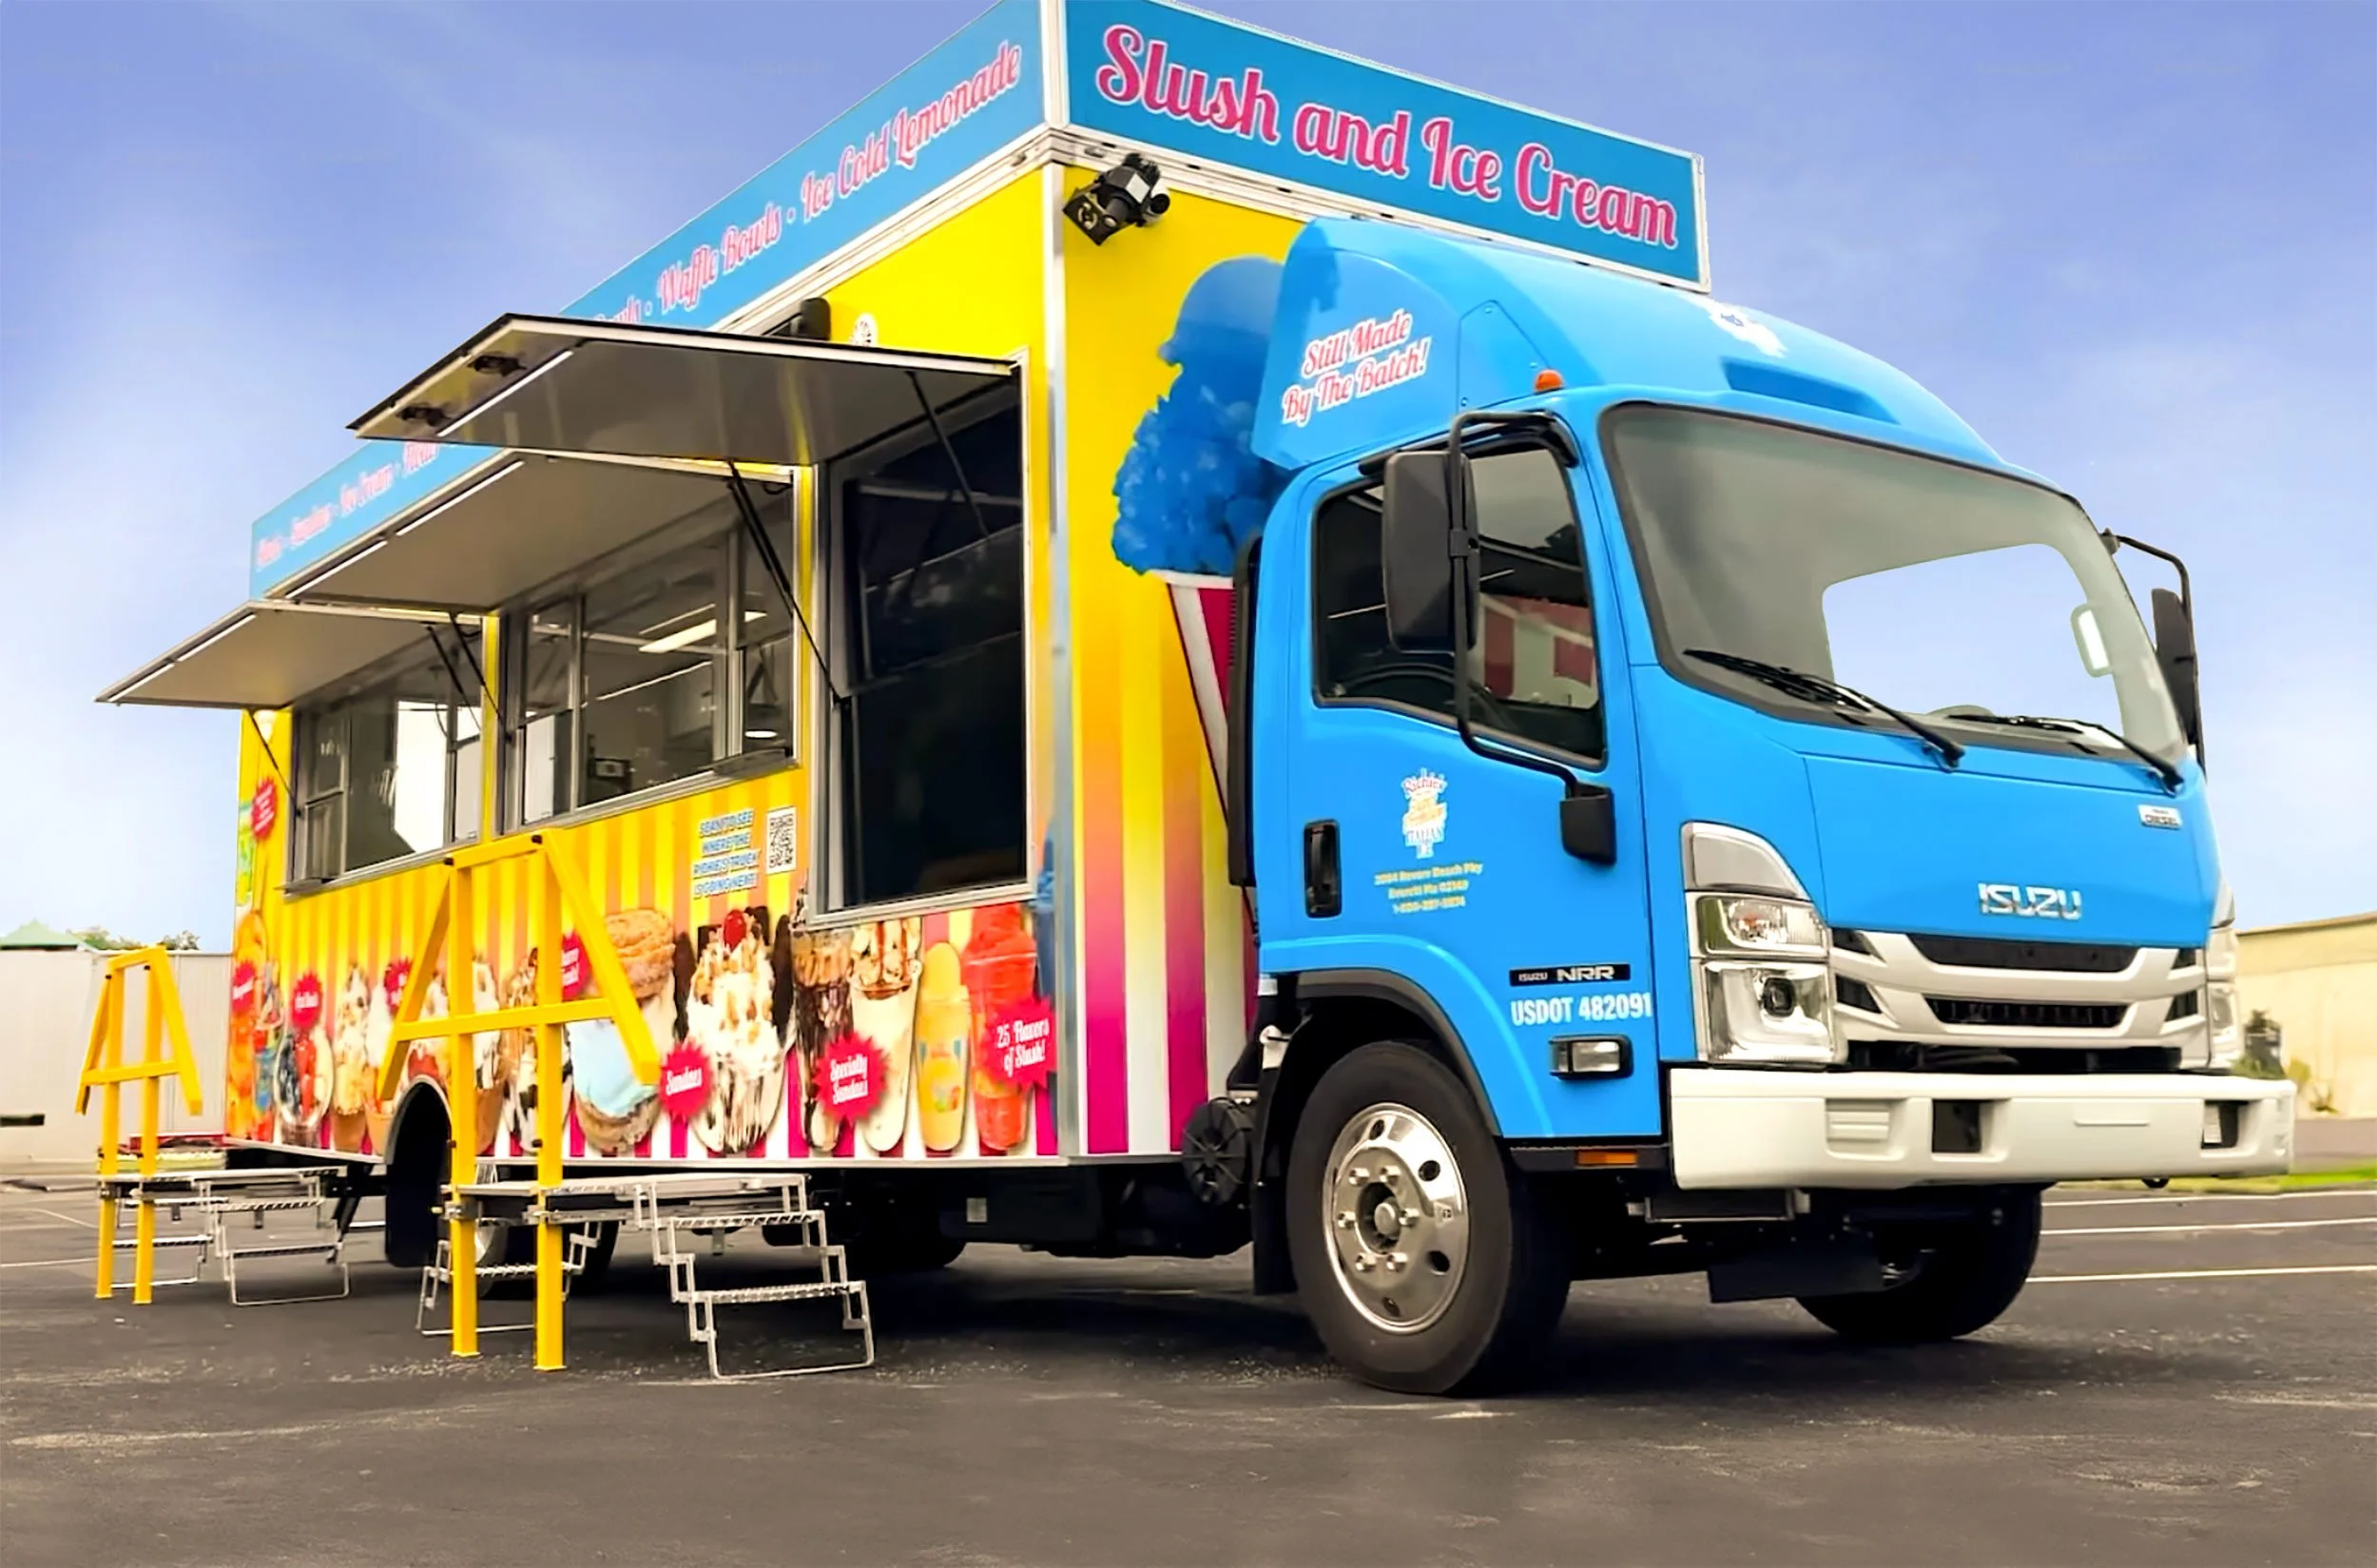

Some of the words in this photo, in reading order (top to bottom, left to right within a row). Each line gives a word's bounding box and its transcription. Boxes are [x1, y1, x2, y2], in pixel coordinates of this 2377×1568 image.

[1096, 24, 1279, 144] Slush
[1293, 99, 1410, 179] and
[1421, 118, 1501, 201] Ice
[1515, 142, 1678, 250] Cream
[656, 243, 720, 315] Waffle
[721, 201, 783, 276] Bowls
[802, 170, 836, 223] Ice
[837, 120, 891, 199] Cold
[892, 39, 1022, 169] Lemonade
[1302, 330, 1349, 378] Still
[1349, 309, 1413, 361] Made
[1283, 385, 1313, 427] By
[1316, 371, 1355, 411] The
[1355, 337, 1431, 397] Batch!
[1978, 881, 2083, 921] ISUZU
[1517, 971, 1549, 982] ISUZU
[1556, 965, 1615, 981] NRR
[1510, 997, 1574, 1027] USDOT
[1578, 992, 1653, 1022] 482091
[995, 1022, 1011, 1049] 25
[1013, 1017, 1051, 1044] Flavors
[830, 1053, 868, 1082] Specialty
[1003, 1046, 1015, 1078] of
[1015, 1037, 1046, 1069] Slush!
